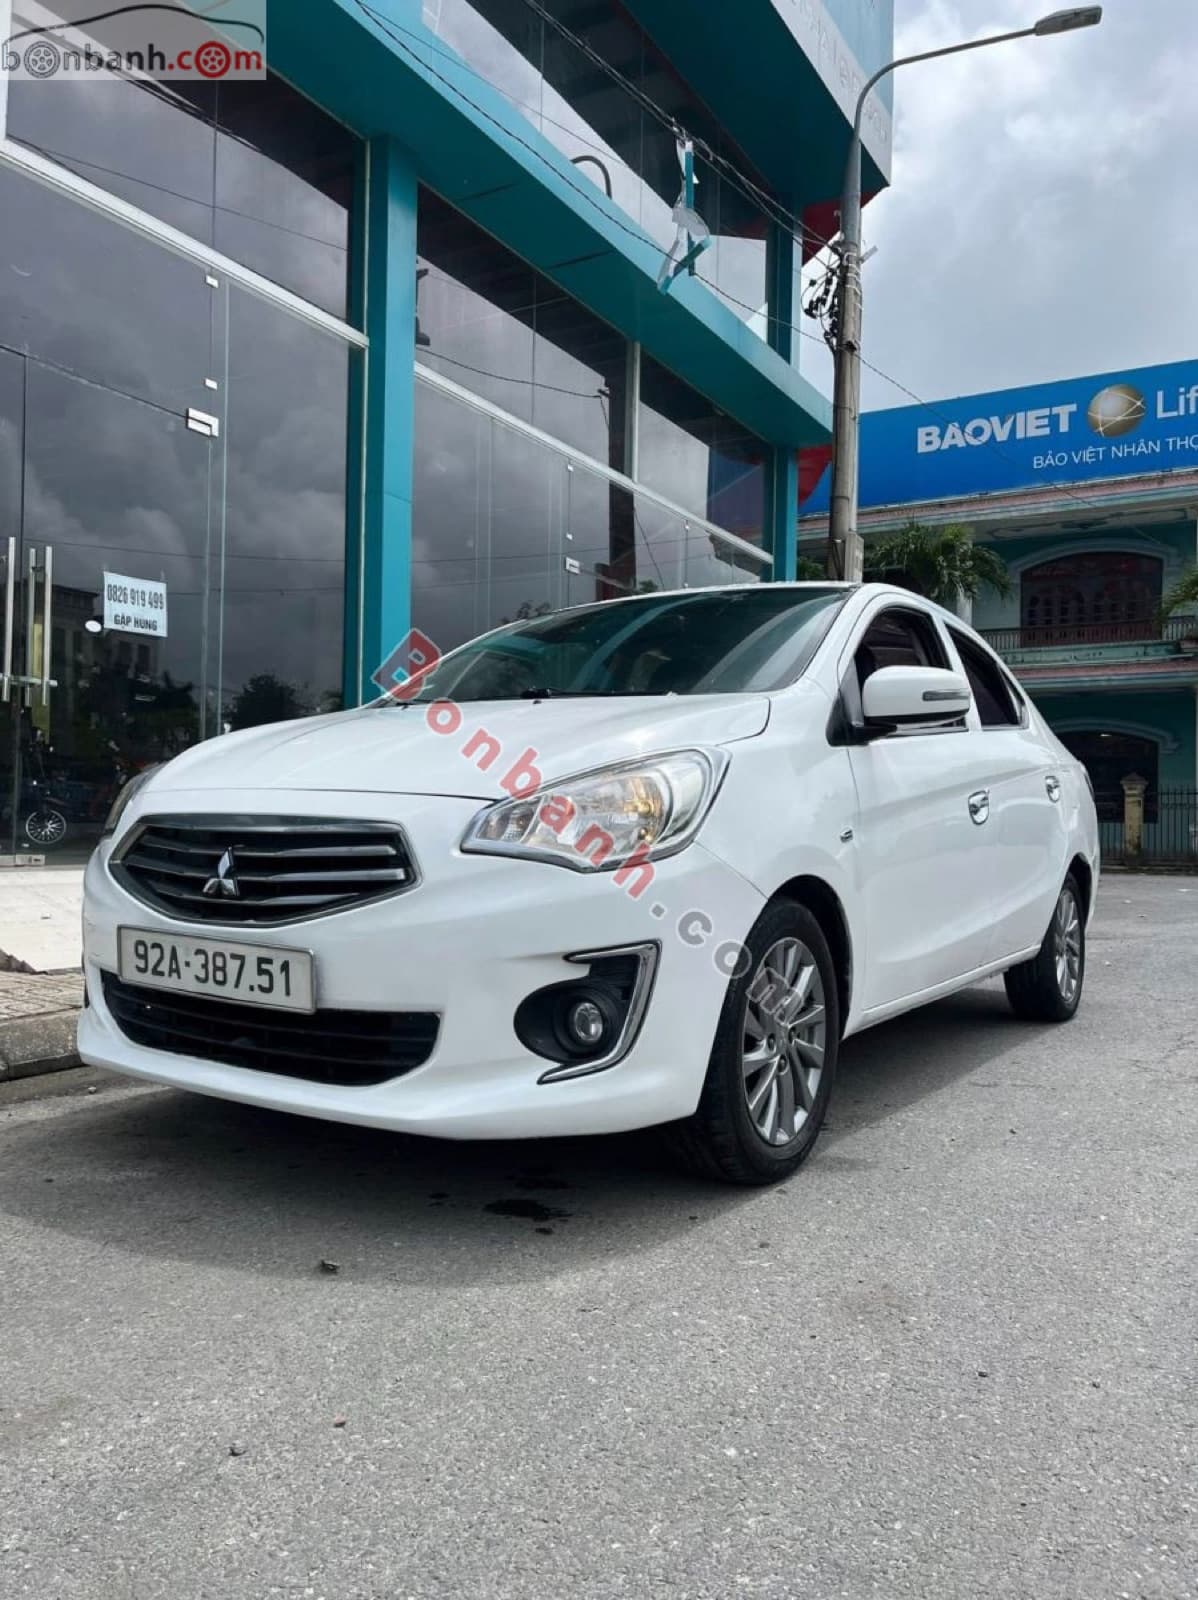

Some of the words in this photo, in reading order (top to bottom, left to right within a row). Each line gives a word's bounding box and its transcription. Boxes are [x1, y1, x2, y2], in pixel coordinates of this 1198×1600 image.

[1032, 450, 1067, 469] BẢO
[1071, 446, 1107, 464] VIỆT
[1111, 439, 1160, 459] NHÂN
[134, 939, 291, 997] 92A-387.51
